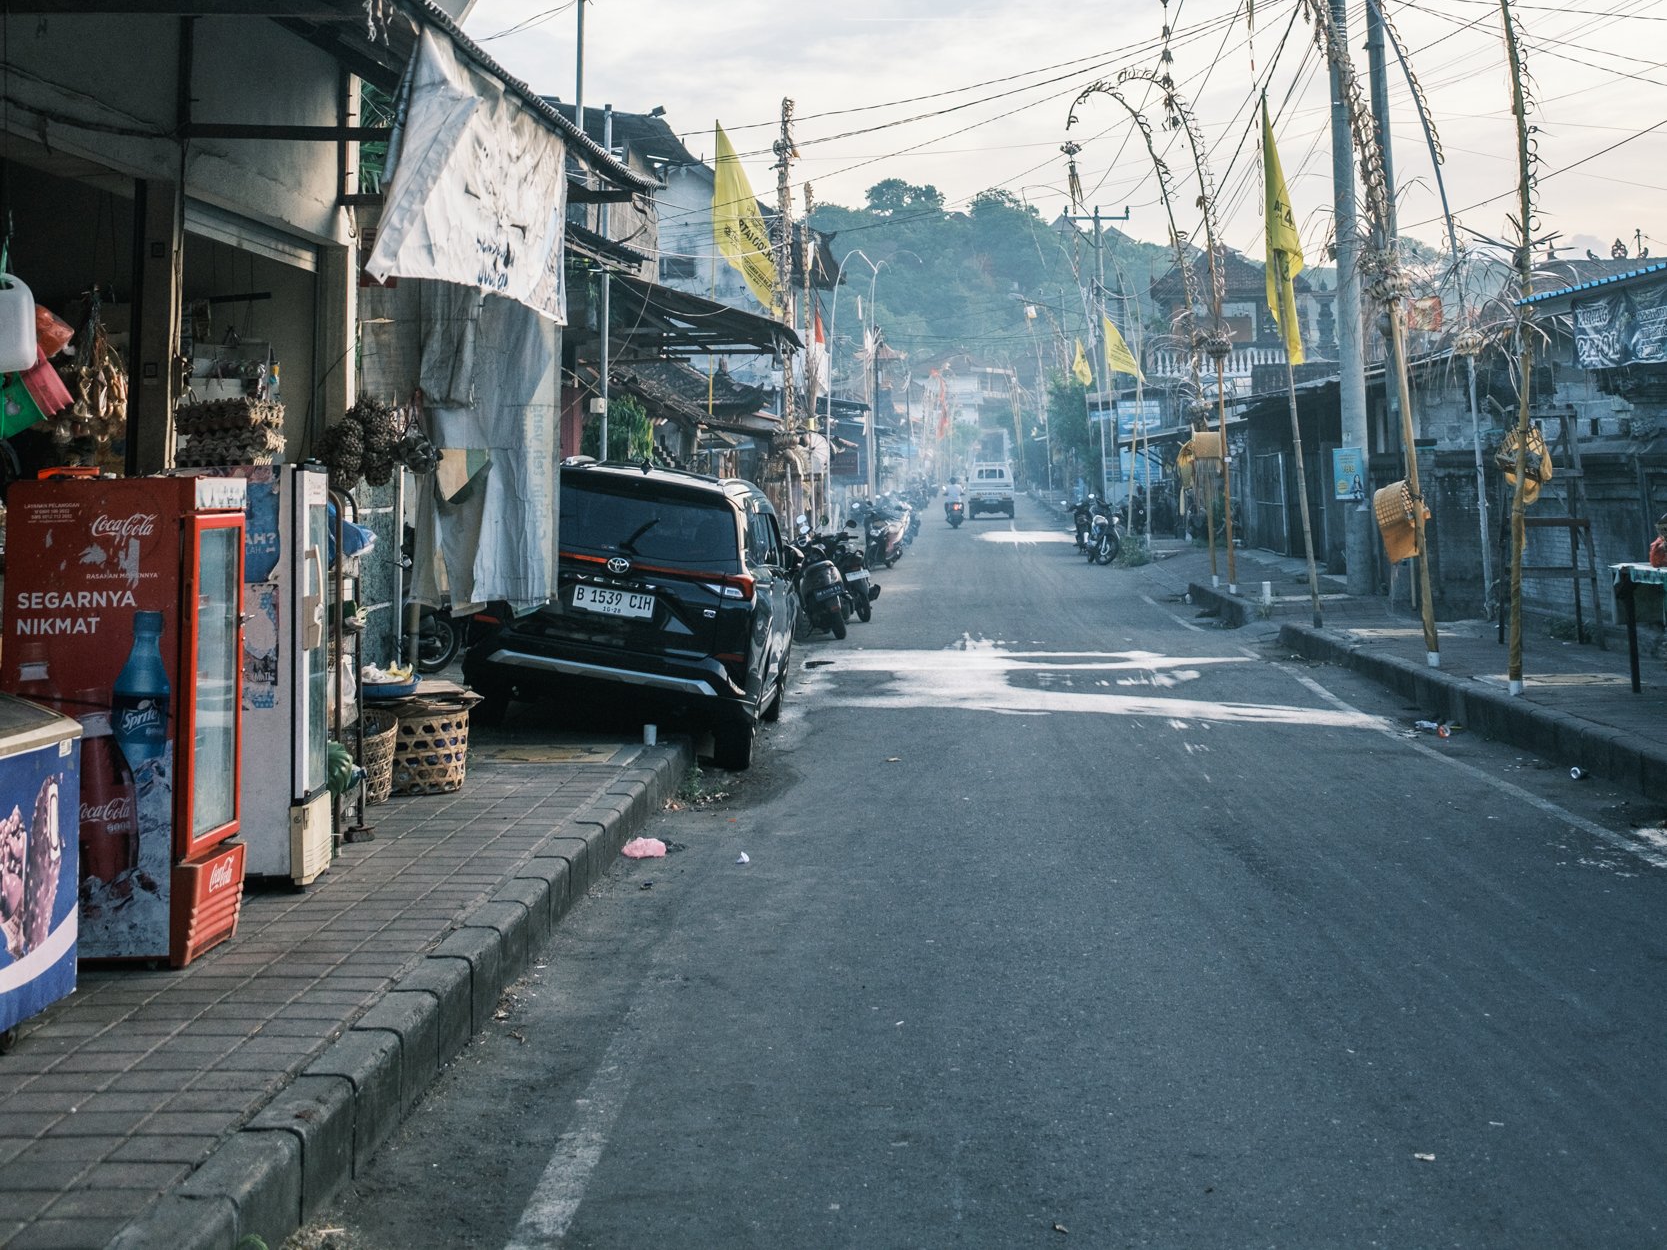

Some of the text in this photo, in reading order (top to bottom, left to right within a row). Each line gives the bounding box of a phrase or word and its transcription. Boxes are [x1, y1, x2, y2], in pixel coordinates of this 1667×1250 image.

[1284, 209, 1293, 228] 4
[91, 512, 158, 537] Coca-Cola
[17, 590, 136, 609] SEGARNYA
[576, 587, 652, 611] B 1539 CIH
[16, 617, 100, 636] NIKMAT
[122, 706, 159, 730] Sprite
